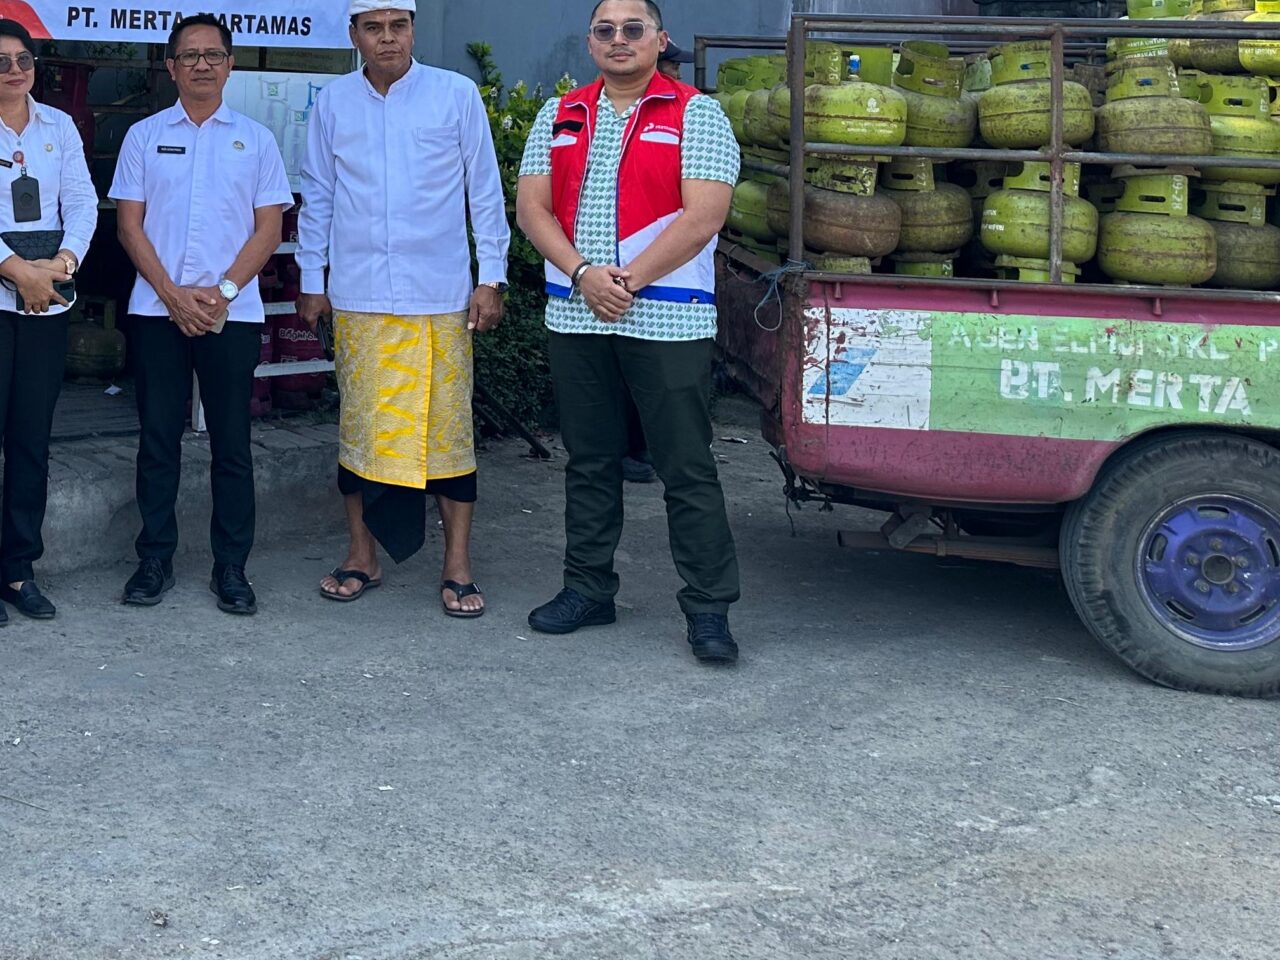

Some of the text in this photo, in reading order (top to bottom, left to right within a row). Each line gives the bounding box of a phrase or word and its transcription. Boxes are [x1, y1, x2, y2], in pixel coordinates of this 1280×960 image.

[67, 6, 98, 28] PT.
[198, 12, 312, 36] ARTAMAS
[1085, 367, 1252, 416] MERTA
